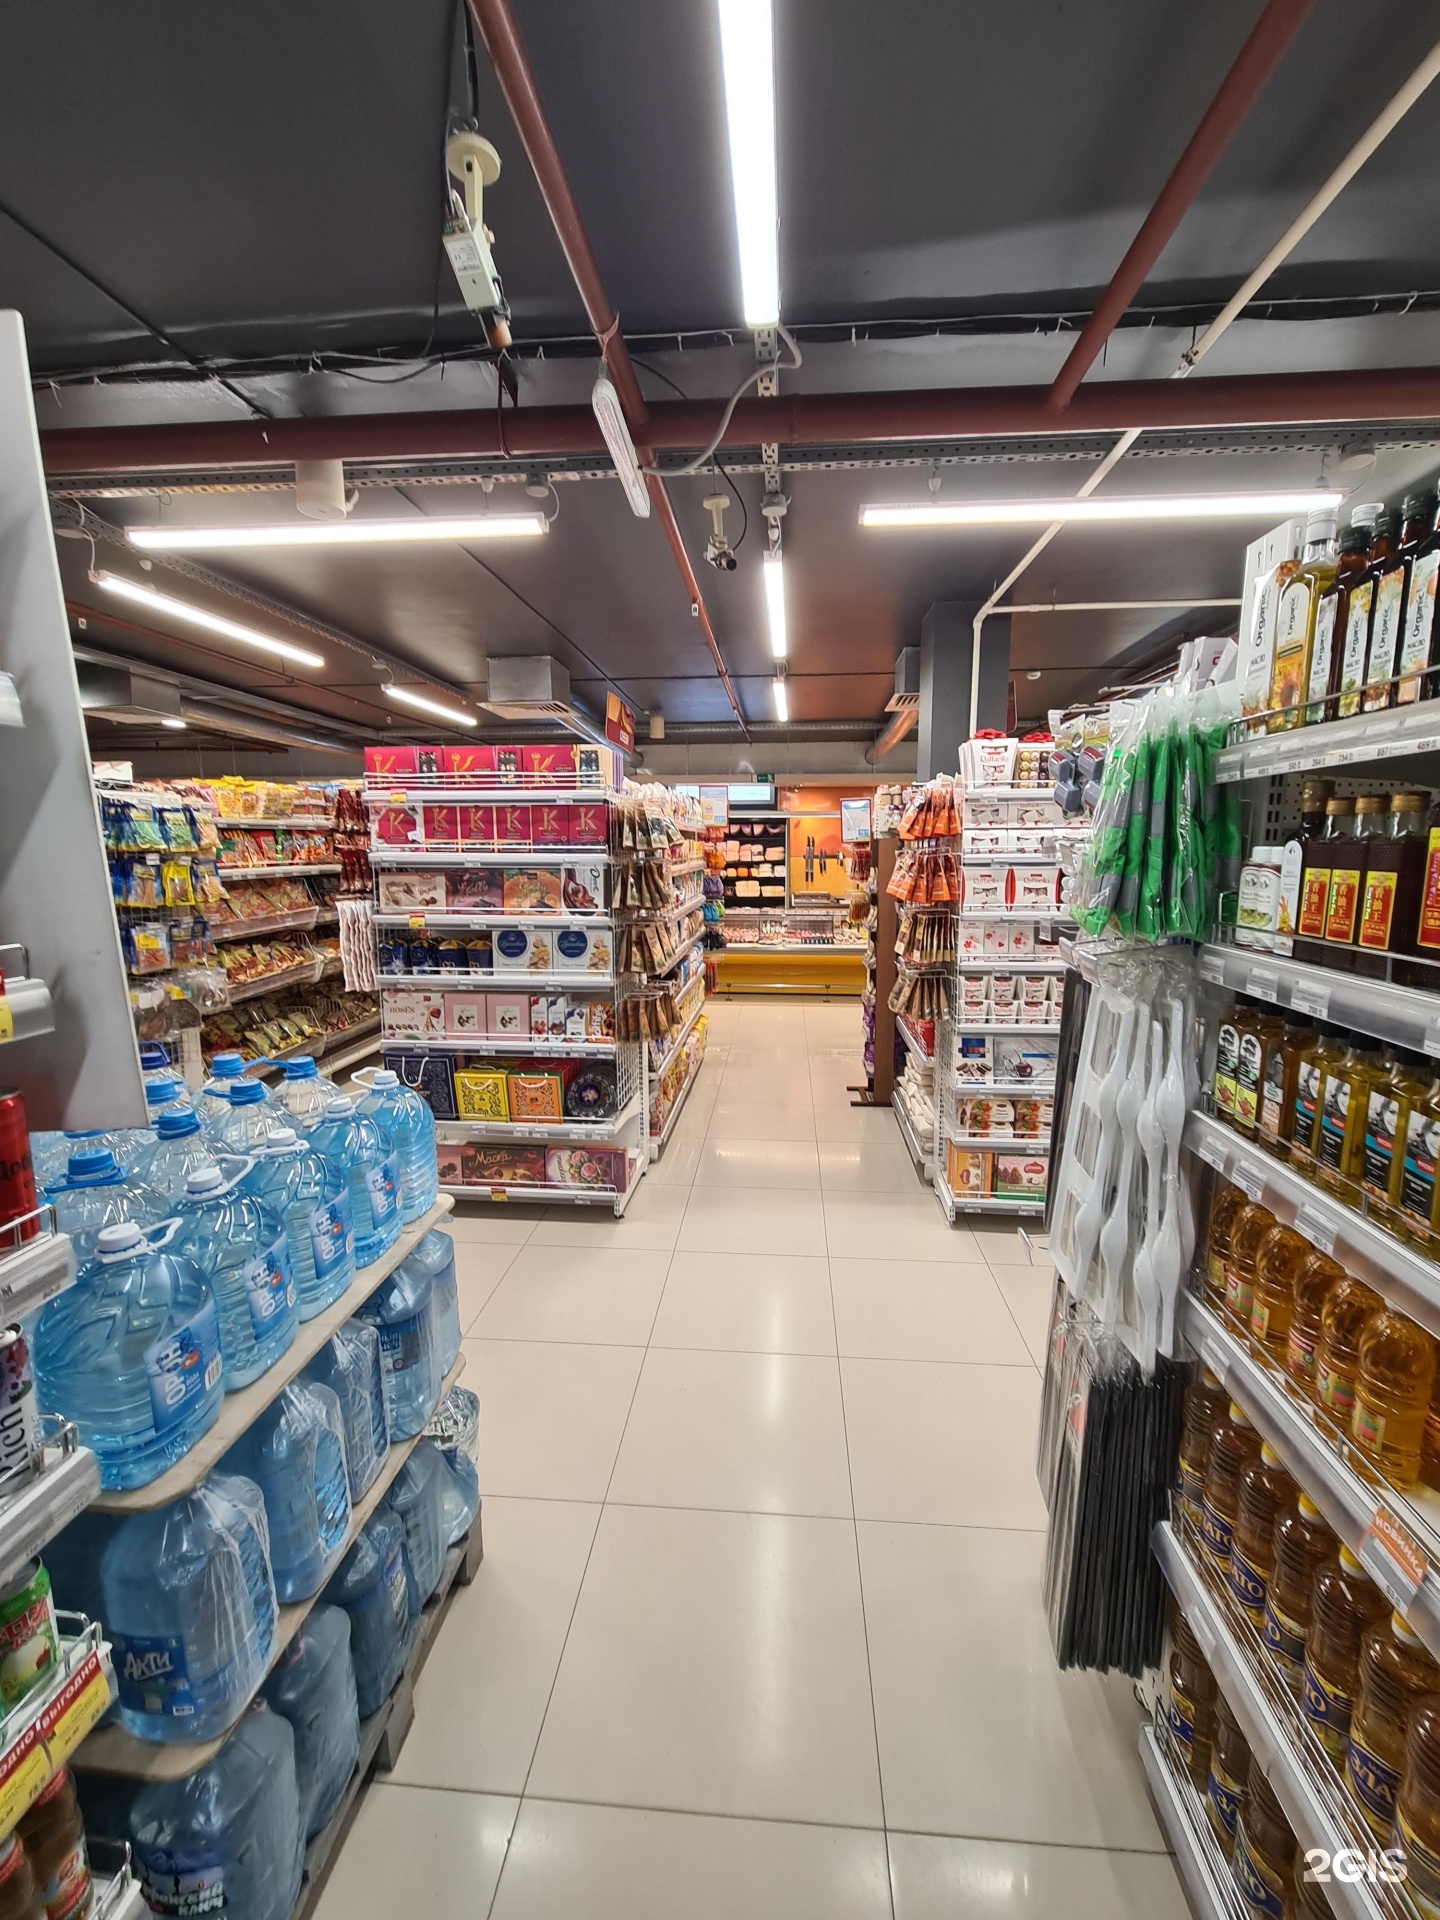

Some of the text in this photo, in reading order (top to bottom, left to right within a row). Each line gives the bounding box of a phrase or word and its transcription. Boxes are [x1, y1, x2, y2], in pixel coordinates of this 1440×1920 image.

[1255, 587, 1268, 648] Organic
[1287, 596, 1297, 636] Organic
[1379, 606, 1391, 649] Organic
[1412, 590, 1425, 638] Organic
[1350, 619, 1360, 658] Organic
[980, 754, 1009, 764] Raffaello
[471, 1150, 512, 1166] Маска
[1375, 1515, 1424, 1579] НОВИНКА
[41, 1656, 97, 1730] ВЫГОДНО
